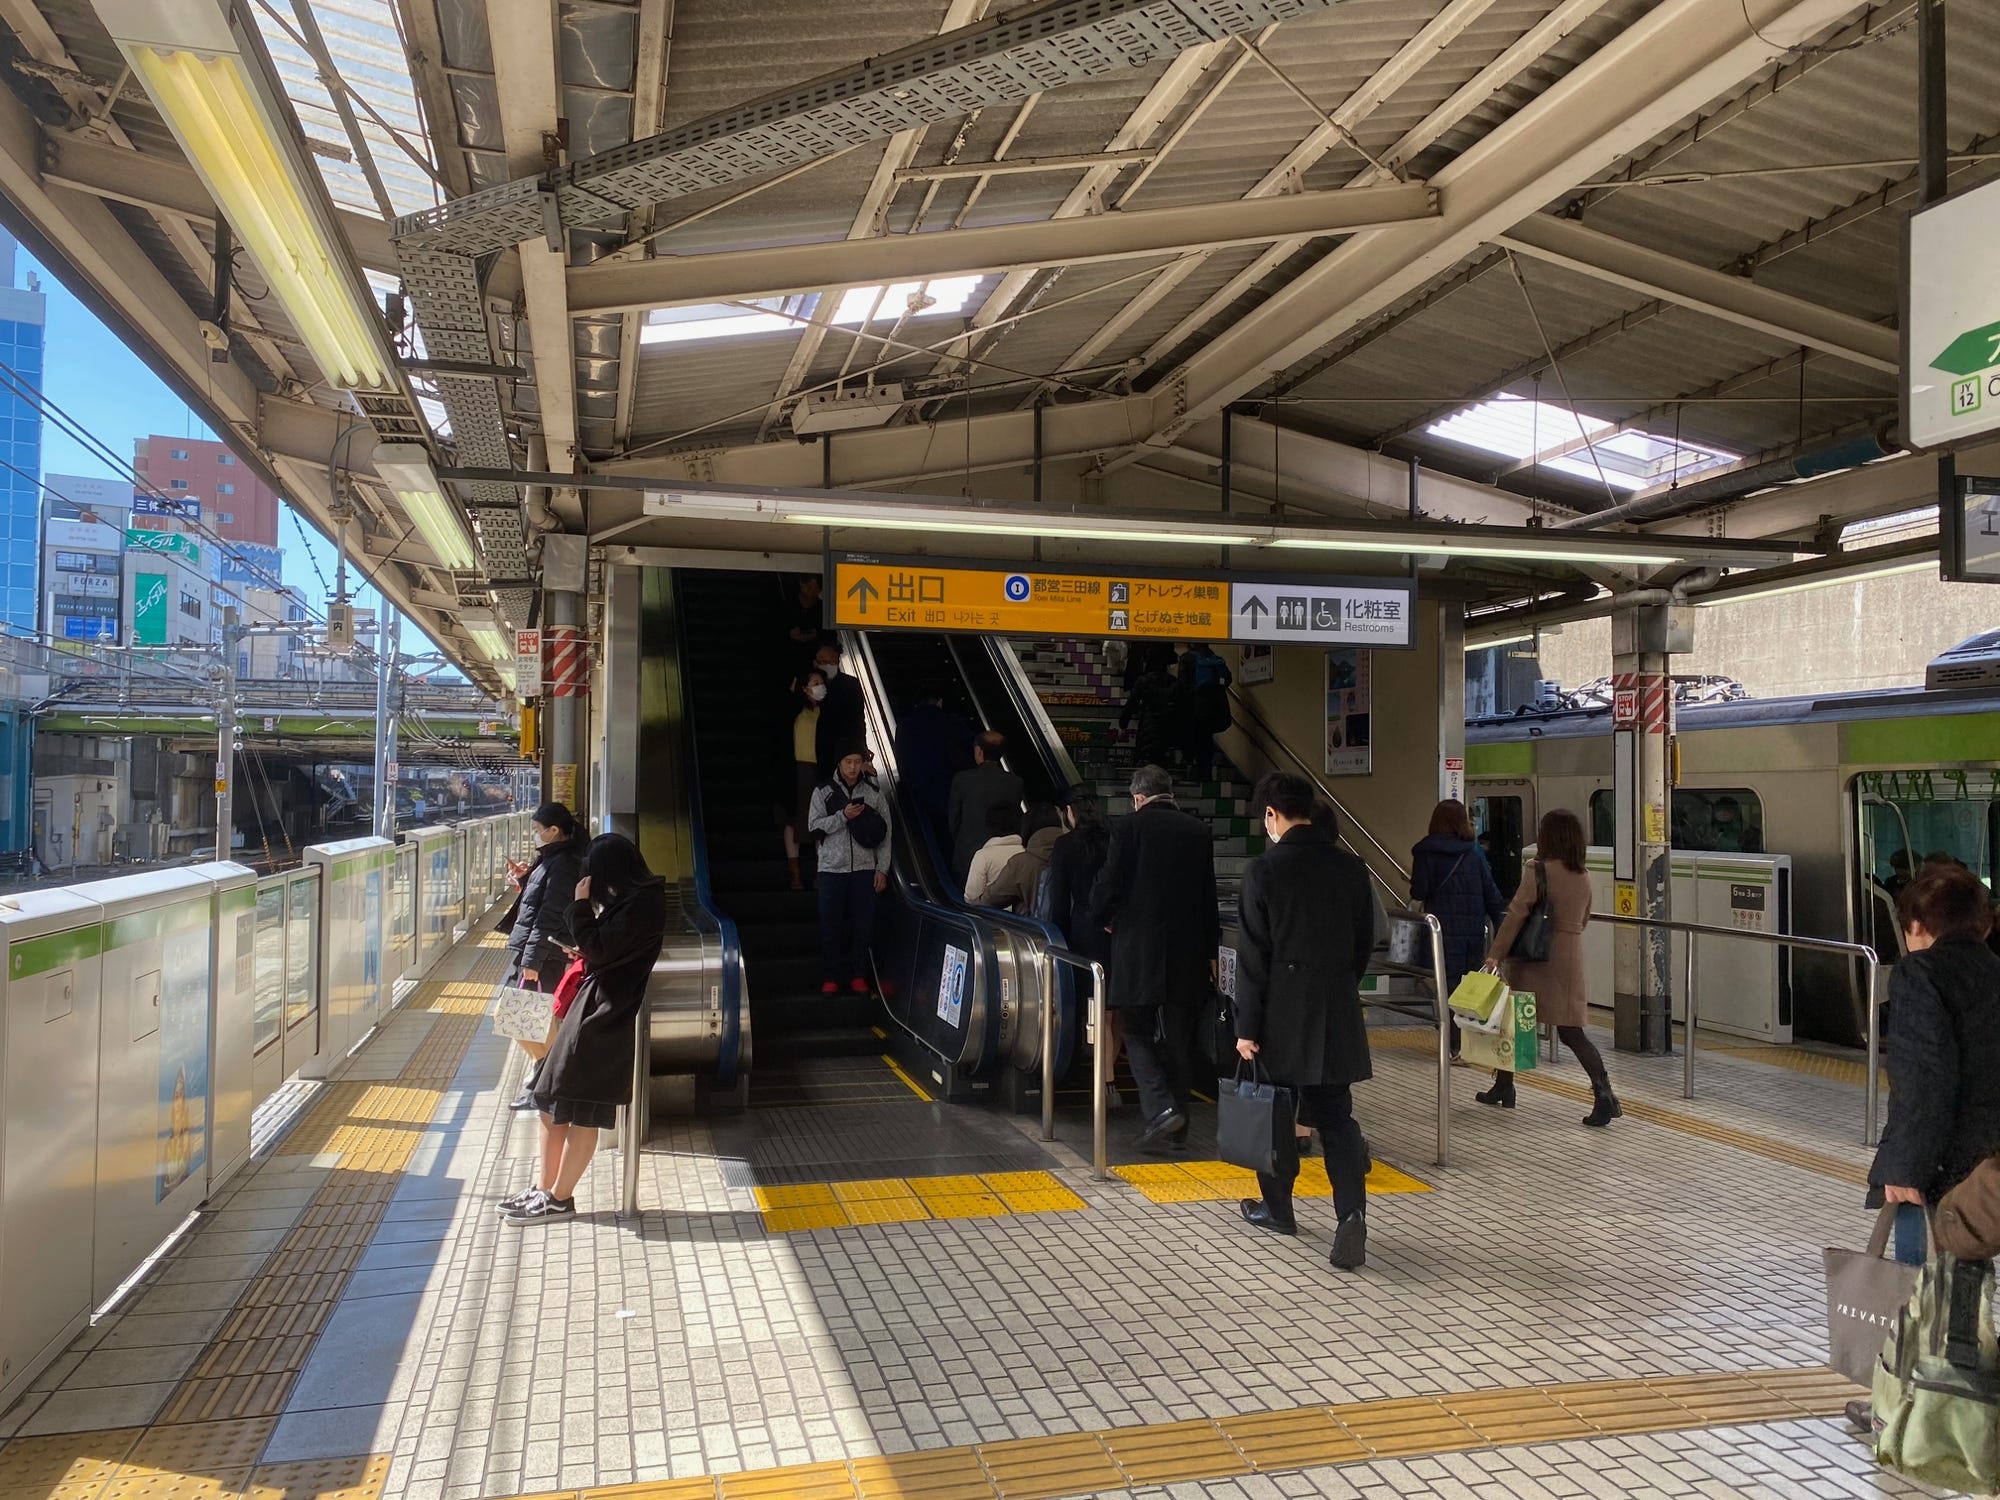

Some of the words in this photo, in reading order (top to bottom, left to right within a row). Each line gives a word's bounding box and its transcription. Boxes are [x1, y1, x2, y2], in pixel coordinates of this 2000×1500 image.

[1961, 383, 1971, 394] JY
[1959, 393, 1974, 408] 12
[74, 576, 108, 586] FORZA
[888, 573, 944, 604] 出口
[1034, 579, 1101, 595] 都営三田線
[1067, 595, 1082, 603] Line
[1134, 584, 1219, 600] アトレヴィ巣鴨
[888, 607, 915, 622] Exit
[925, 608, 944, 623] 出口
[954, 611, 985, 626] 나가는
[1345, 599, 1401, 620] 化粧室
[1133, 610, 1212, 626] とげぬき地蔵
[1345, 621, 1394, 632] Restrooms
